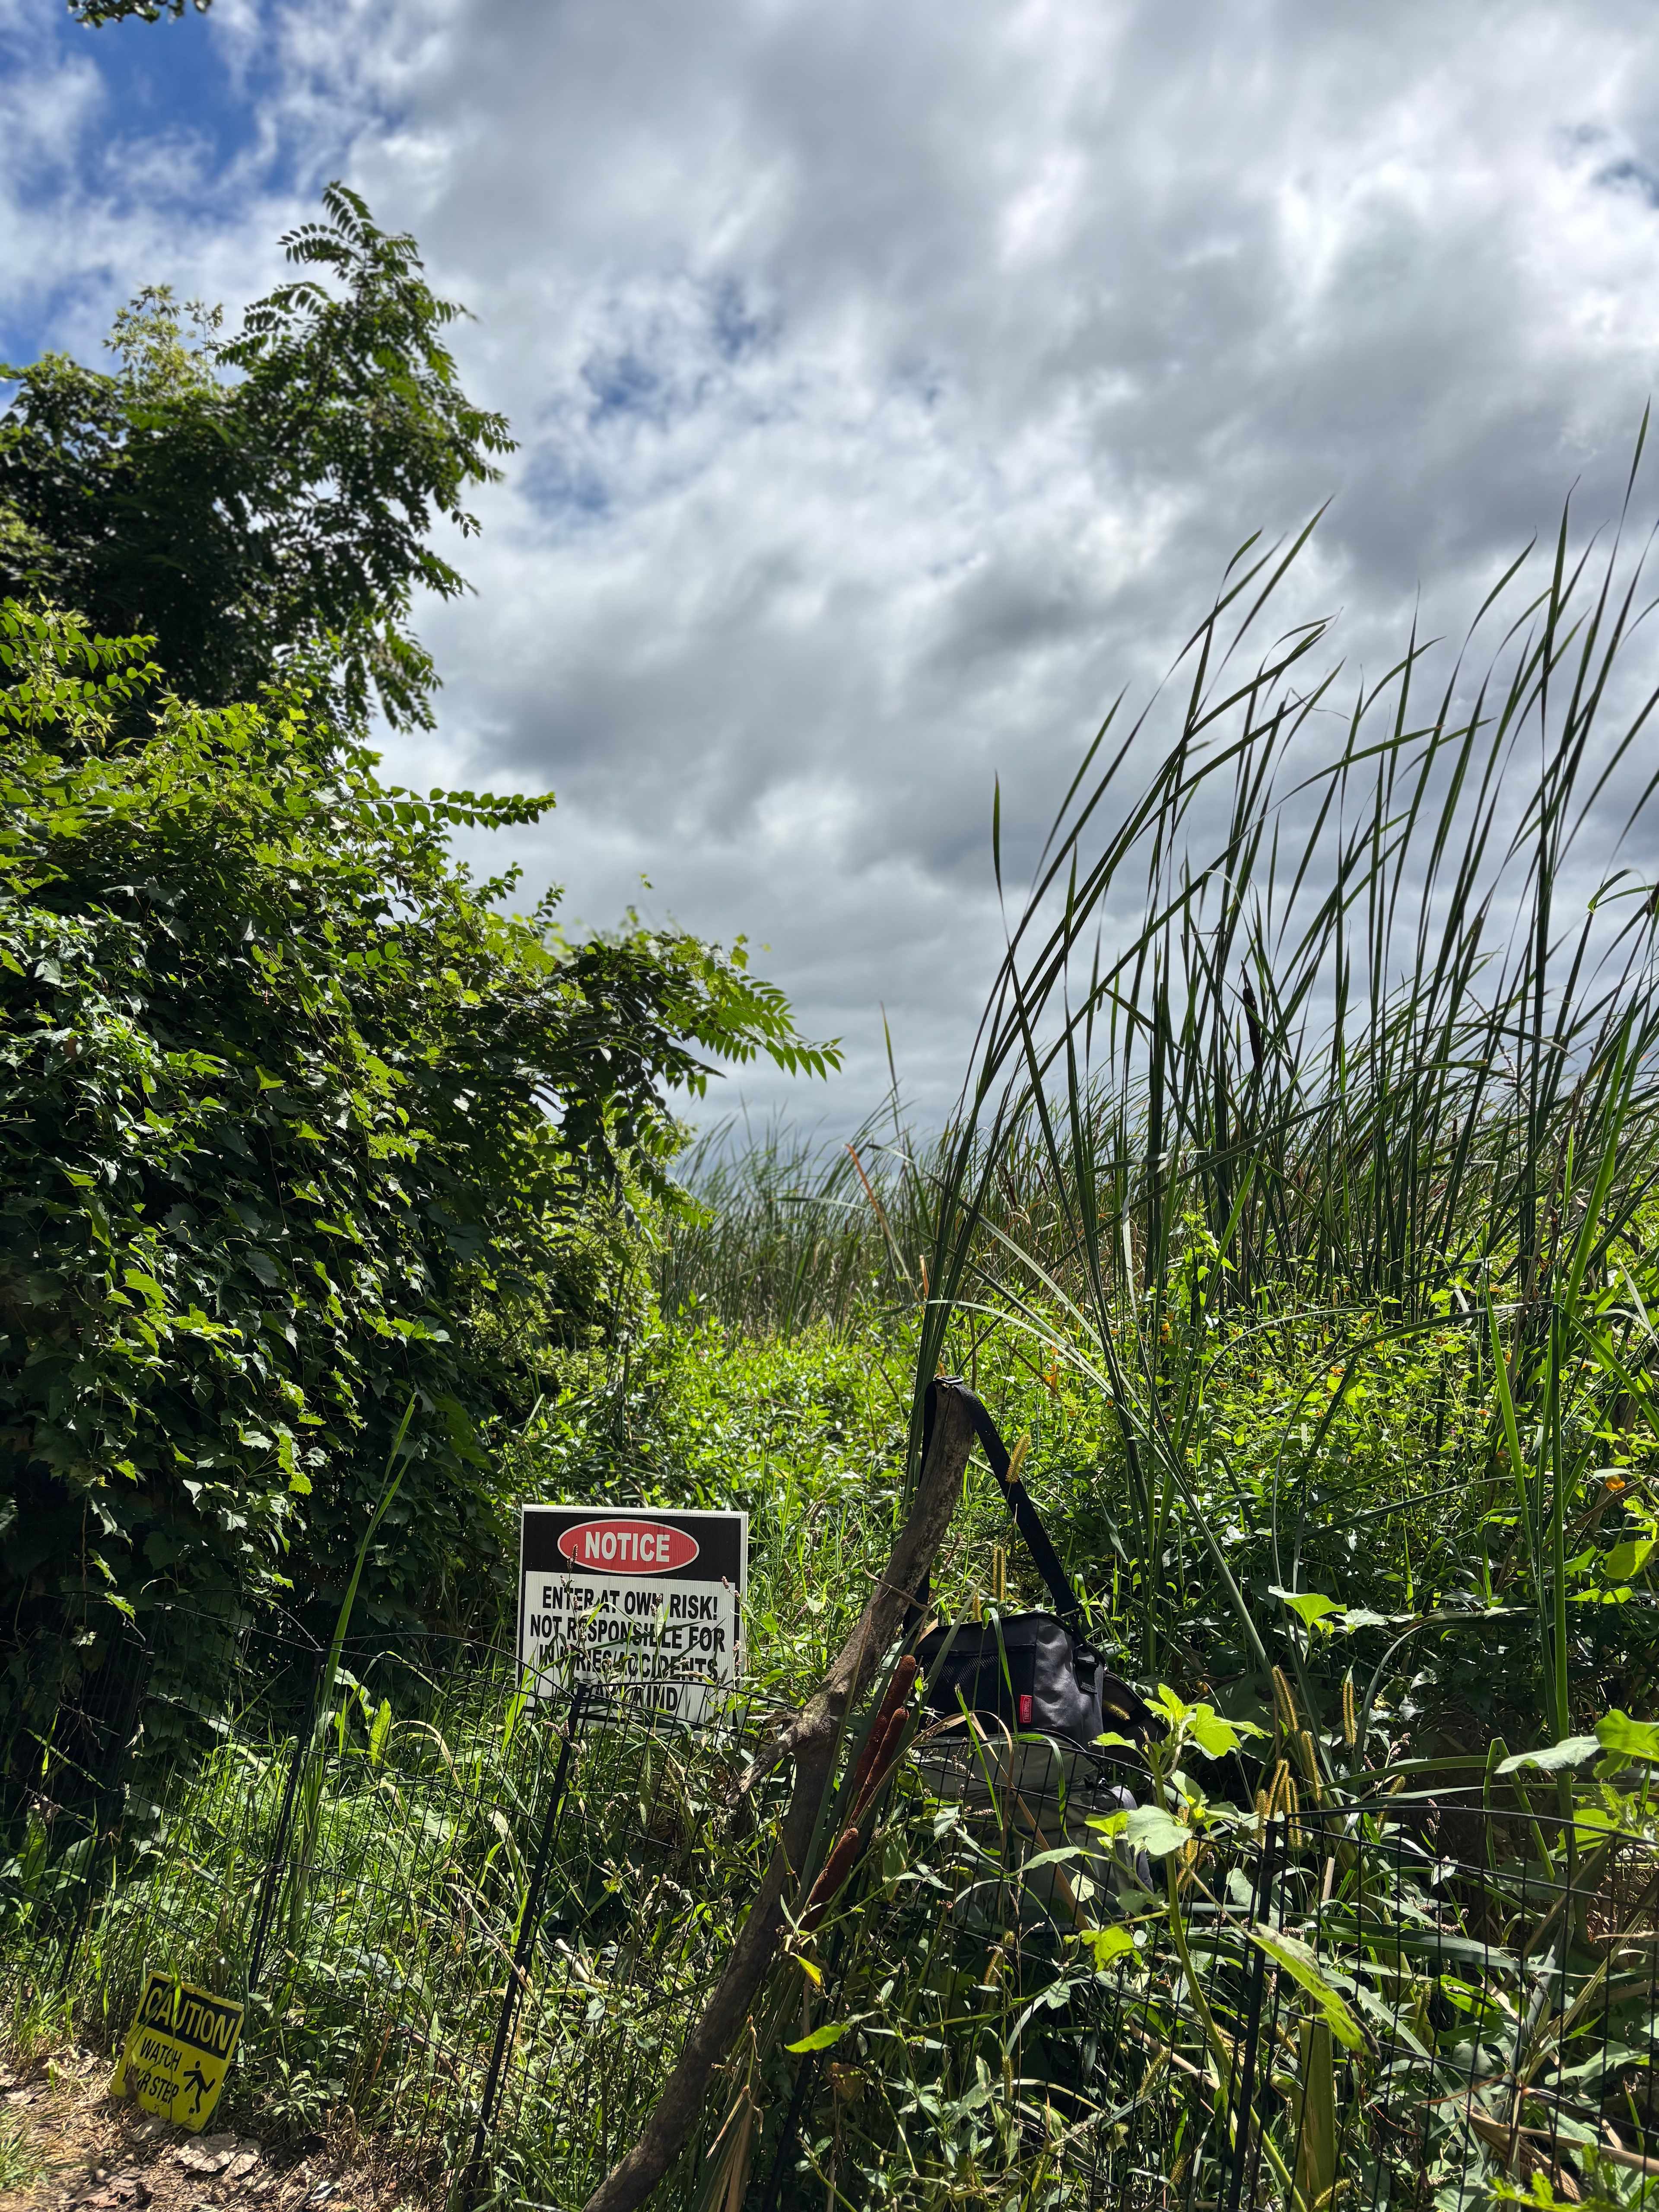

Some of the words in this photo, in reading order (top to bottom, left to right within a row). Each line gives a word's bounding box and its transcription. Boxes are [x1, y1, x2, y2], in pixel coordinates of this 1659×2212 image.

[585, 1531, 671, 1563] NOTICE
[543, 1586, 594, 1611] ENTER
[599, 1589, 620, 1614] AT
[670, 1594, 718, 1621] RISK!
[530, 1614, 562, 1639] NOT
[689, 1626, 725, 1653] FOR
[634, 1684, 678, 1711] KIND
[145, 1986, 236, 2051] CAUTION
[140, 2037, 183, 2072] WATCH
[122, 2061, 152, 2093] YR
[149, 2076, 180, 2104] STEP
